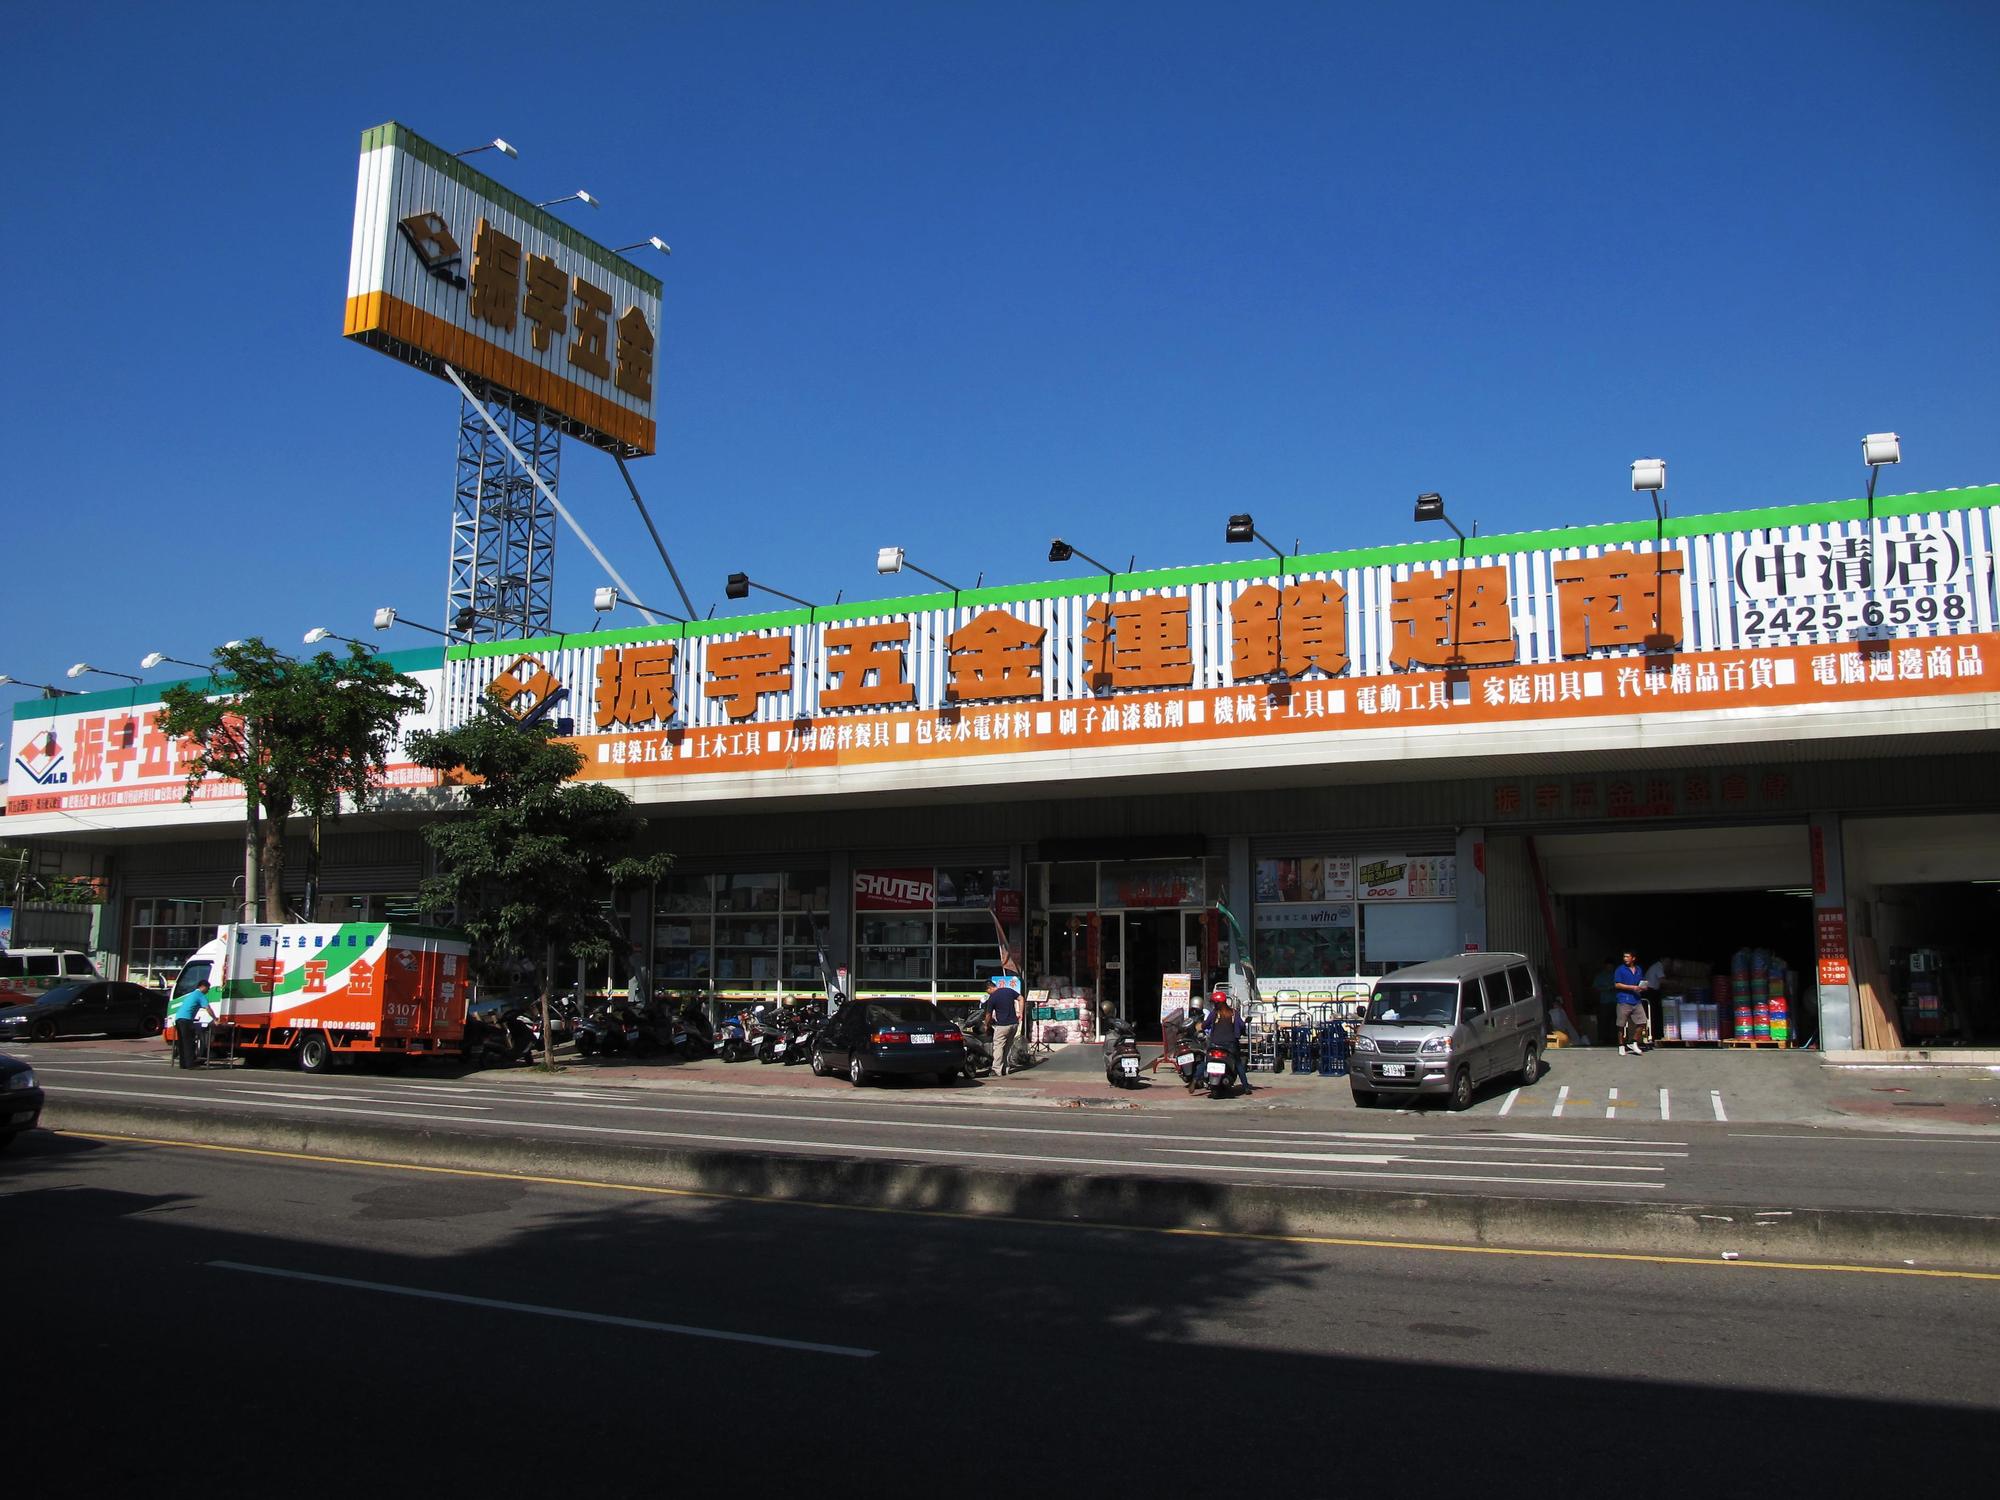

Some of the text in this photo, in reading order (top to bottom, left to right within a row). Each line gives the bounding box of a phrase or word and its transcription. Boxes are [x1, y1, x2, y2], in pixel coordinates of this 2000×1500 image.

[470, 218, 654, 402] 振宇五金
[1735, 529, 1961, 598] (中清店)
[593, 548, 1684, 728] 振宇五金連鎖超商
[1744, 594, 1967, 635] 2425-6598
[611, 736, 674, 765] 建築五金
[696, 731, 761, 760] 土木工具
[915, 711, 1032, 745] 包裝水電材料
[1059, 699, 1184, 736] 刷子油漆黏劑
[1214, 690, 1324, 724] 機械手工具
[1356, 680, 1449, 715] 電動工具
[1482, 671, 1582, 705] 家庭用具
[1616, 656, 1774, 699] 汽車精品百貨
[1310, 910, 1338, 922] wiha
[223, 958, 374, 996] 宇五金
[387, 1003, 417, 1016] 3107
